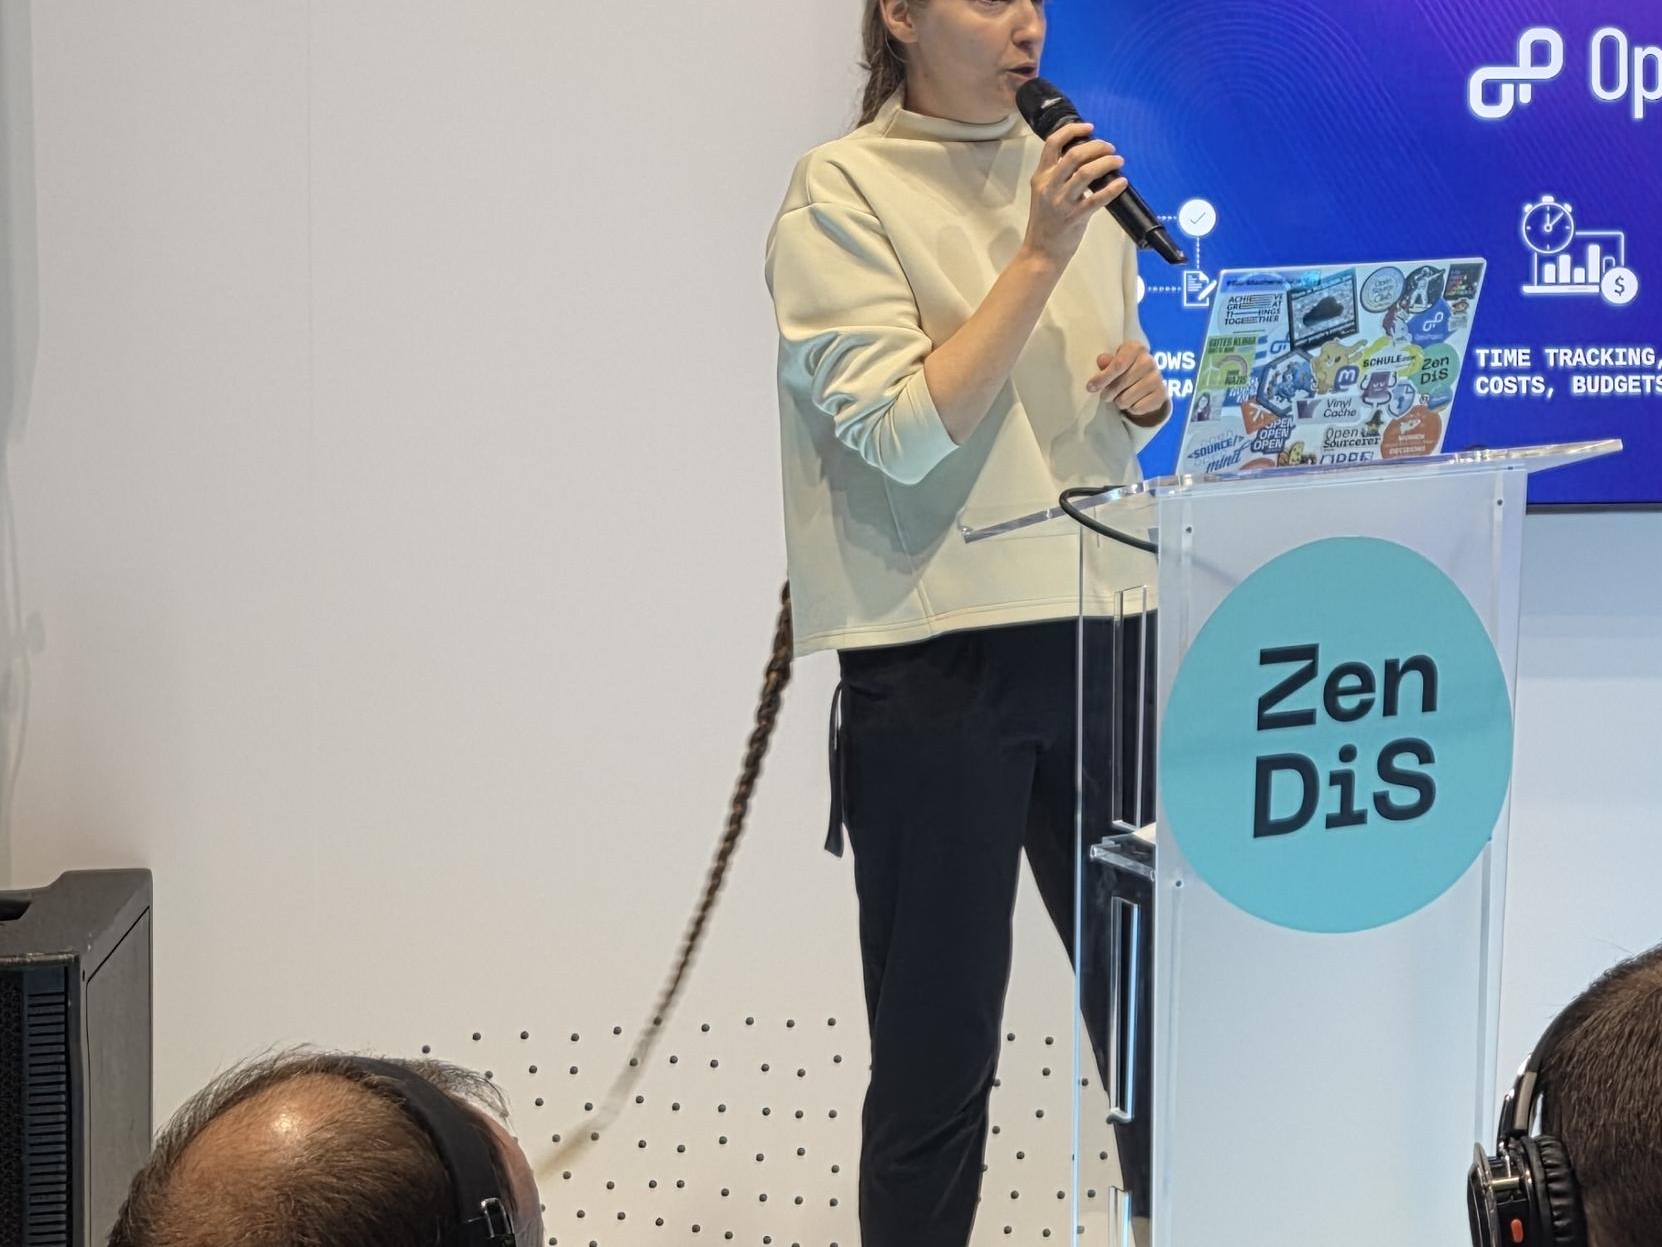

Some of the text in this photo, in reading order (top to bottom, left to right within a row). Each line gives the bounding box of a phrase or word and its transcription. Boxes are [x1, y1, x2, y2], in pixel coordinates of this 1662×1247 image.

[1362, 355, 1402, 368] SCHULE
[1421, 356, 1450, 371] Zen
[1475, 348, 1532, 368] TIME
[1420, 368, 1449, 385] DiS
[1473, 375, 1554, 399] COSTS,
[1327, 397, 1353, 410] Vinyl
[1323, 408, 1357, 418] Cache
[1259, 428, 1290, 440] OPEN
[1325, 426, 1359, 441] Open
[1253, 439, 1284, 450] OPEN
[1322, 437, 1381, 449] Sourcerer
[1256, 643, 1438, 732] Zen
[1252, 737, 1436, 839] DiS
